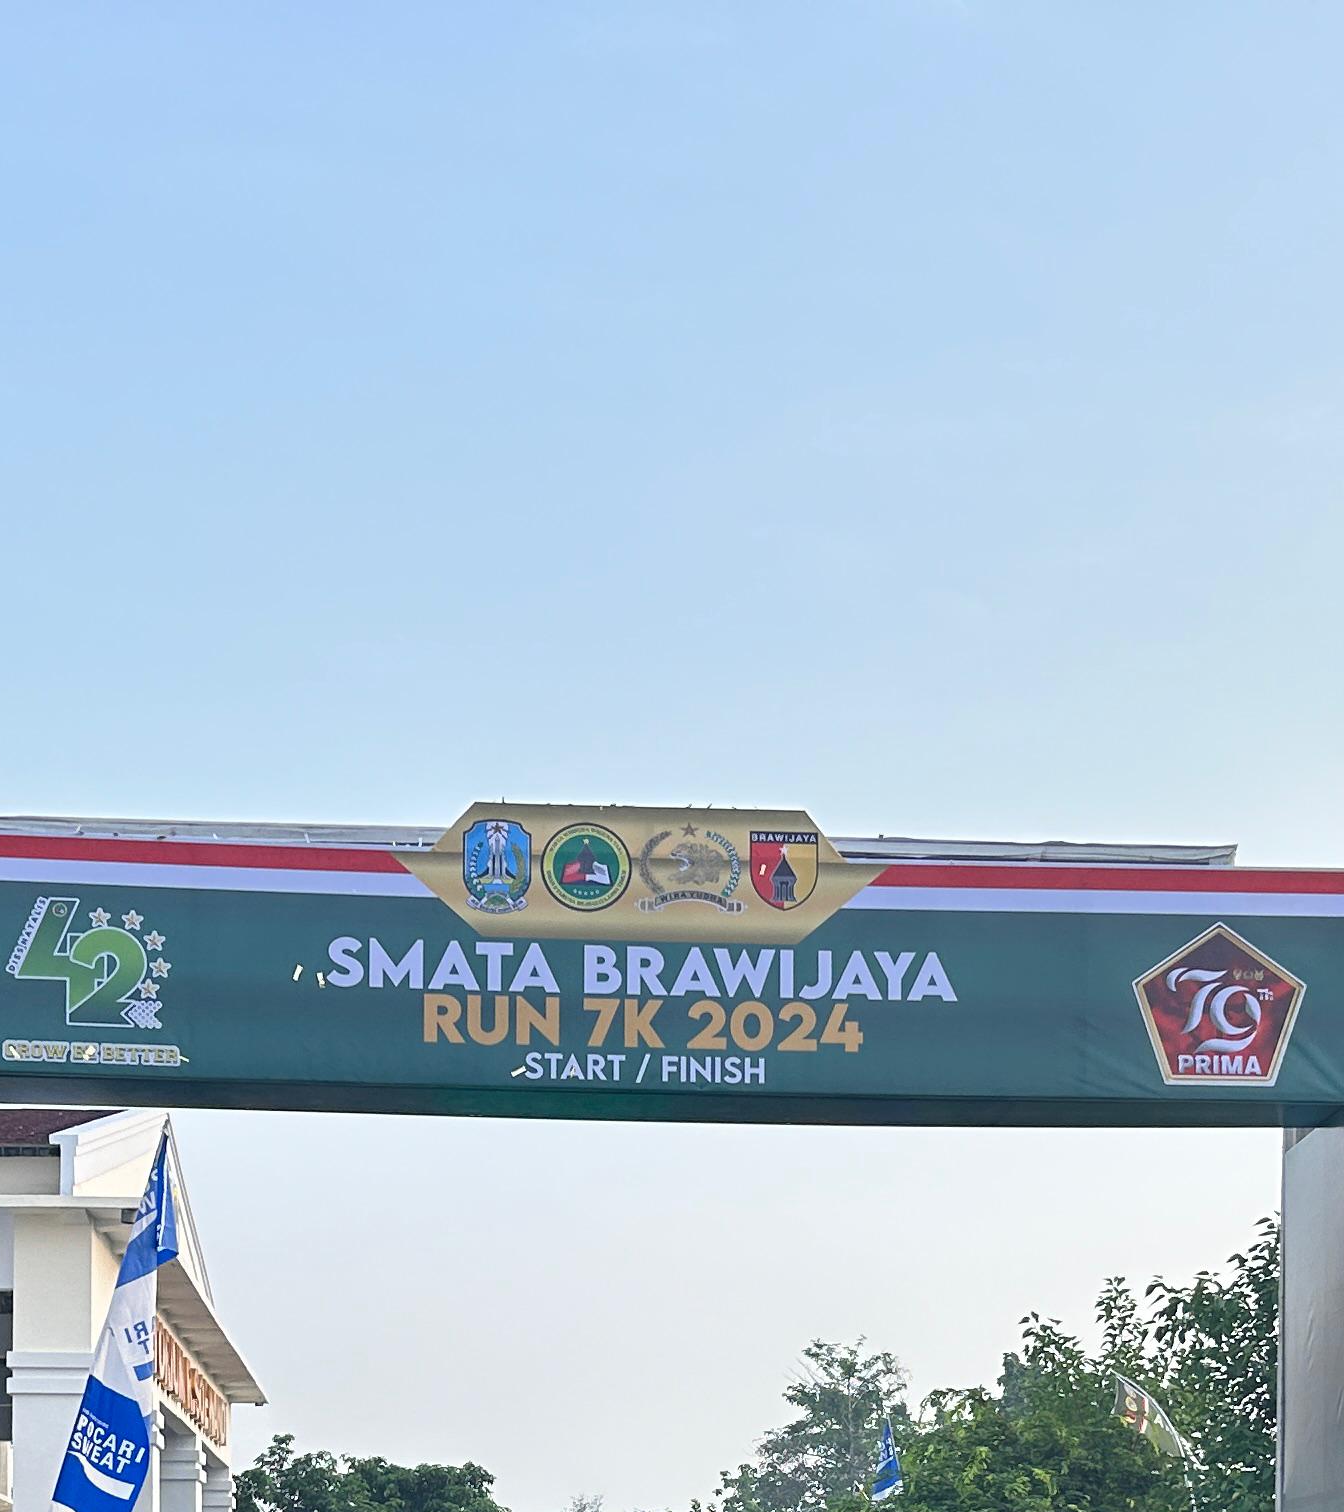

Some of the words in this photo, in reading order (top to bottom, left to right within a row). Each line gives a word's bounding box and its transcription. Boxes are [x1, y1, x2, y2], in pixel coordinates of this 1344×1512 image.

[751, 833, 817, 844] BRAWIJAYA
[15, 897, 148, 1027] 42
[327, 936, 560, 993] SMATA
[583, 942, 958, 1002] BRAWIJAYA
[423, 994, 560, 1046] RUN
[582, 999, 665, 1048] 7K
[686, 1001, 863, 1052] 2024
[102, 1045, 178, 1066] BETTER
[524, 1052, 626, 1082] START
[635, 1054, 649, 1084] /
[661, 1055, 765, 1084] FINISH
[1178, 1055, 1262, 1075] PRIMA
[71, 1431, 131, 1474] SWEAT
[76, 1414, 146, 1463] POCARI
